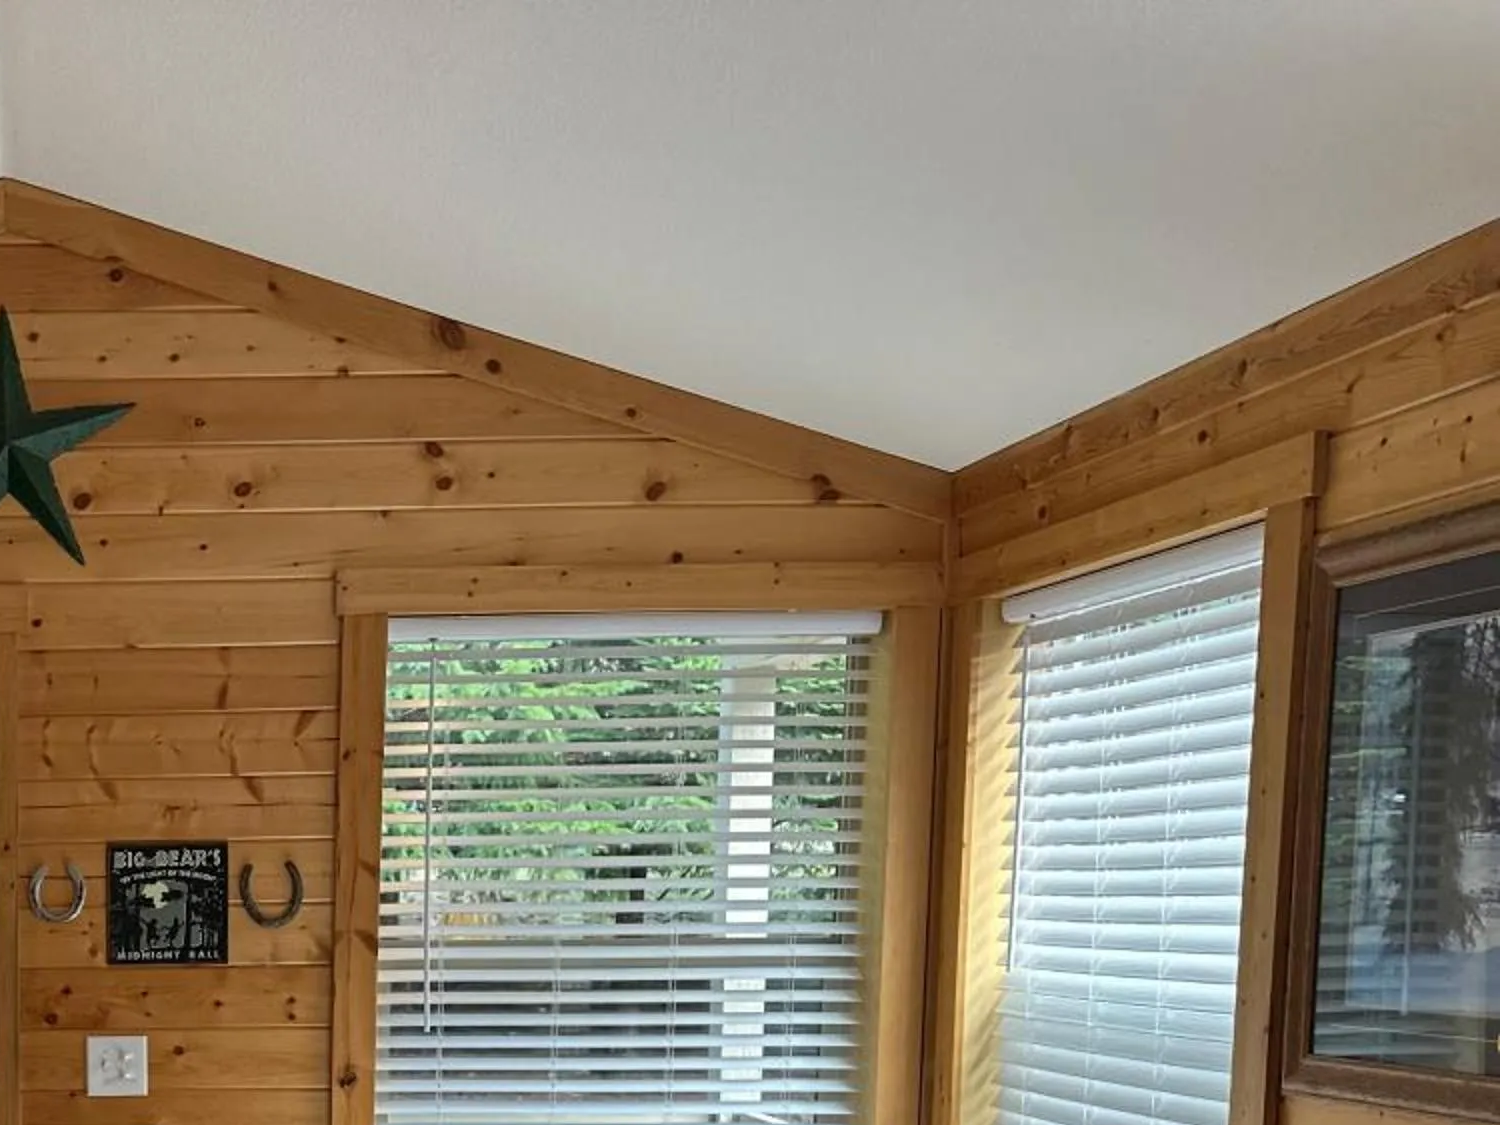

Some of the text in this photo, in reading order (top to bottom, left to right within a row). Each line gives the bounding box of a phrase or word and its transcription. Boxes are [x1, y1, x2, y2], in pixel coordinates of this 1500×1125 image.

[114, 849, 221, 869] BIG BEAR'S
[116, 949, 219, 960] MIDNIGHT BALL
